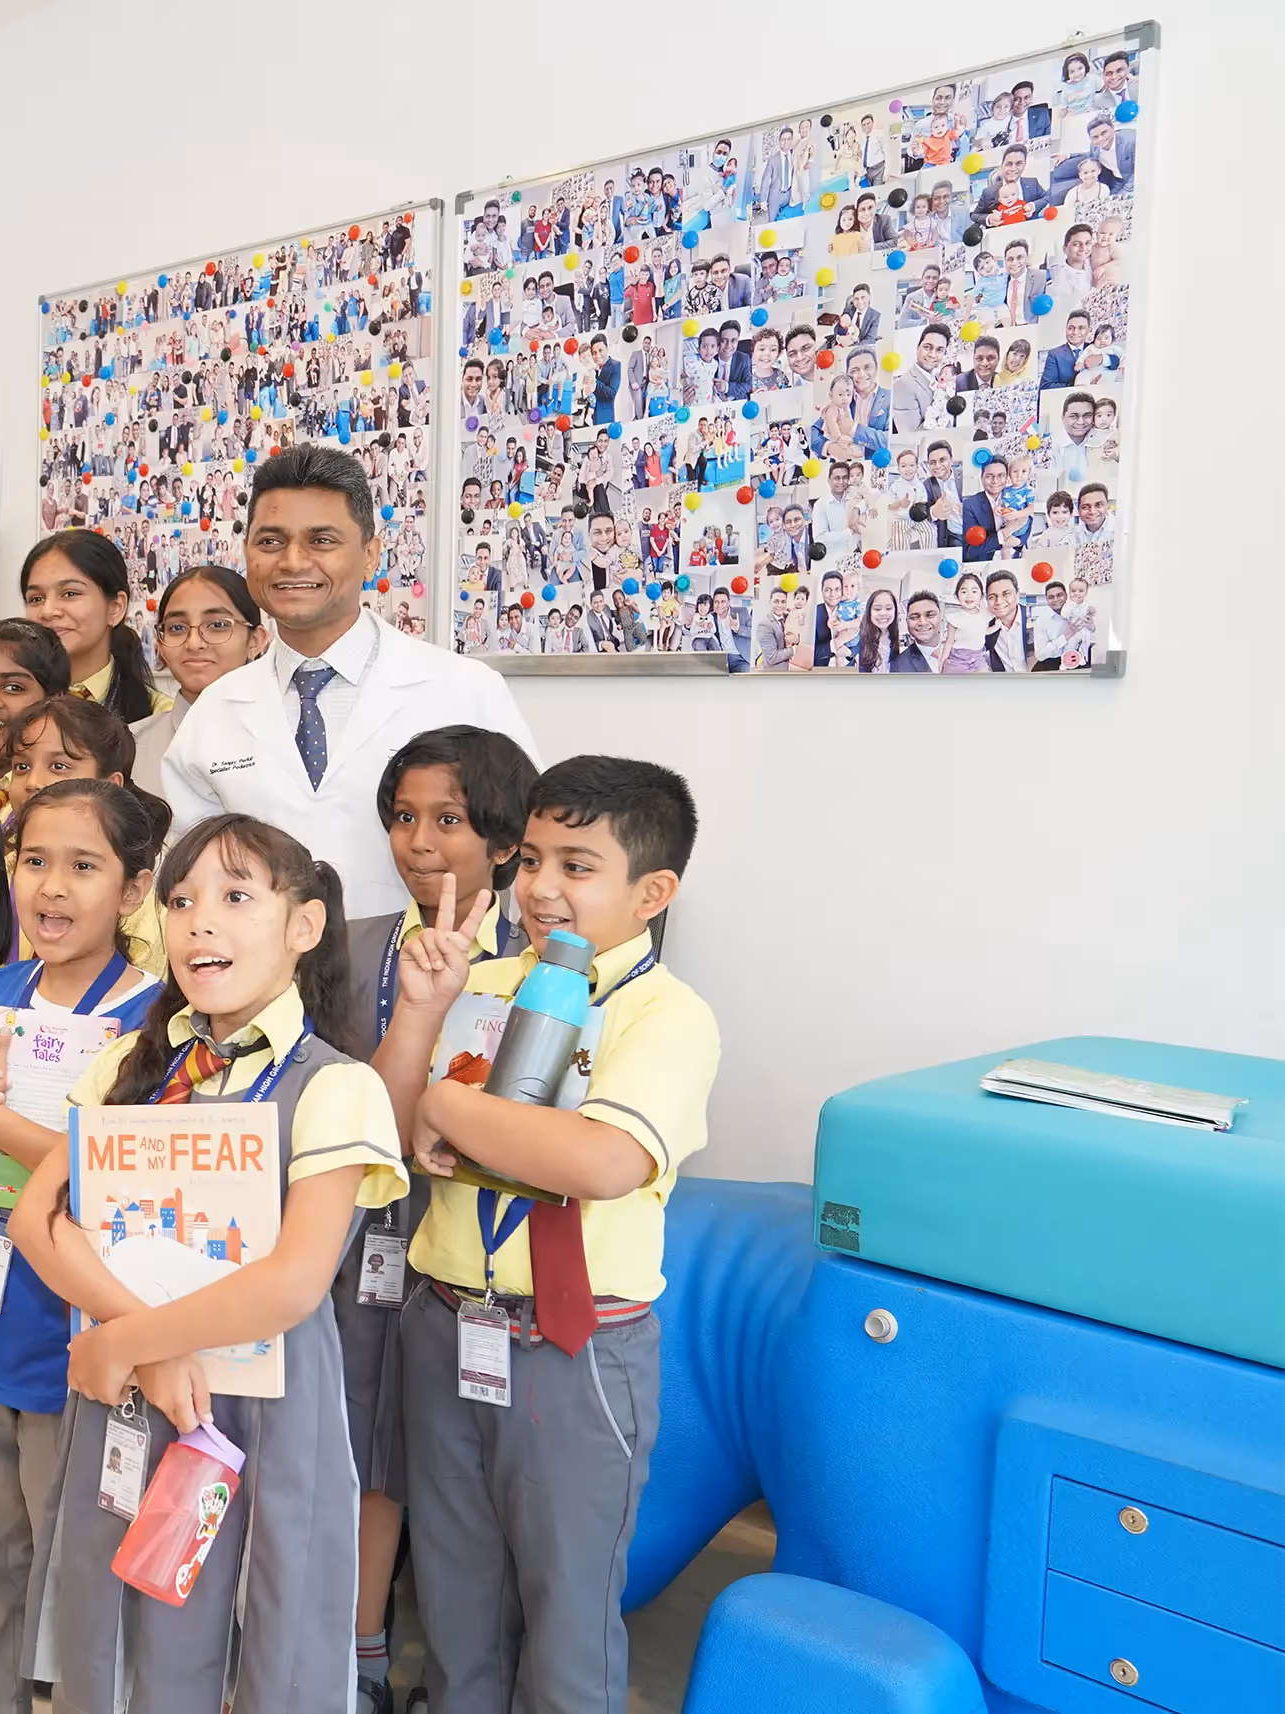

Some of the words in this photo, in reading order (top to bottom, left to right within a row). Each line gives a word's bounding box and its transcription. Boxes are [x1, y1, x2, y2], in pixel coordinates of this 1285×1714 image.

[383, 957, 391, 976] INDIAN
[630, 966, 640, 978] OF
[33, 1034, 65, 1053] fairy
[33, 1049, 61, 1062] Tales
[258, 1076, 274, 1093] HIGH
[87, 1134, 136, 1171] ME
[140, 1136, 164, 1152] AND
[170, 1133, 264, 1171] FEAR
[148, 1156, 166, 1170] MY
